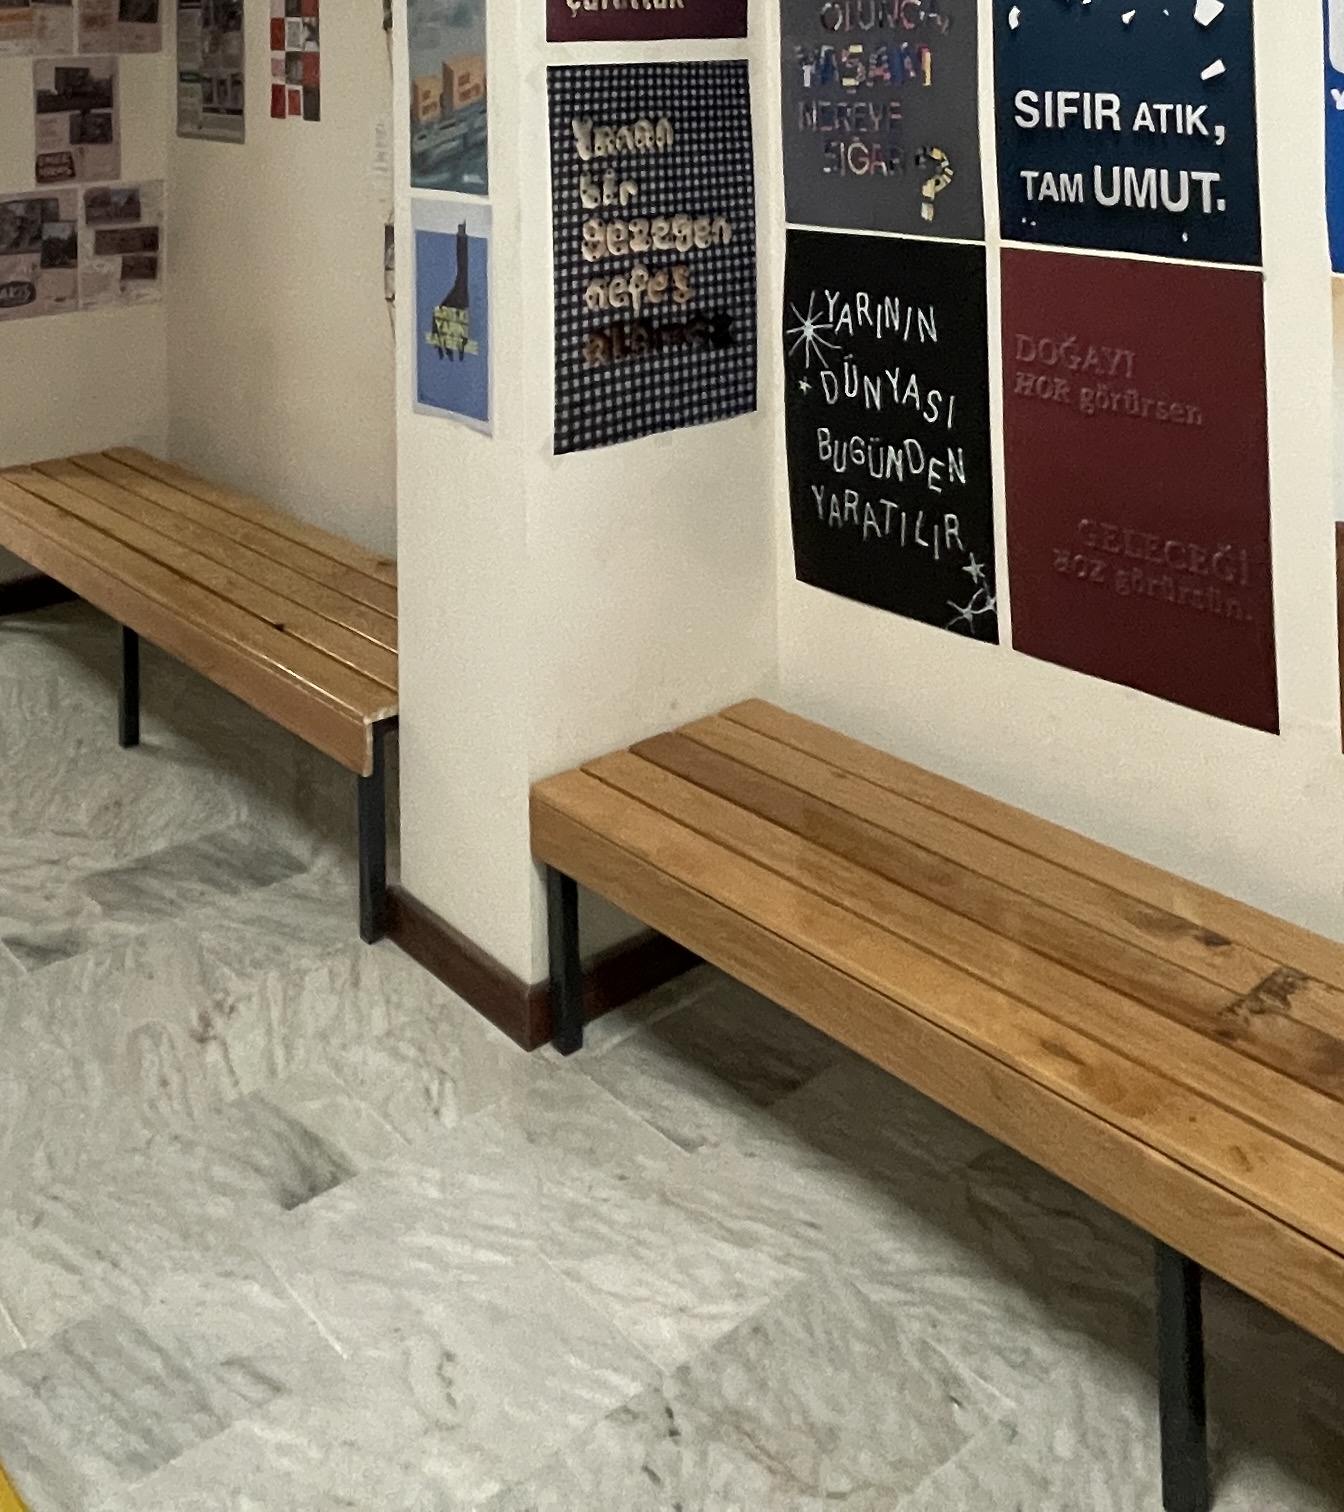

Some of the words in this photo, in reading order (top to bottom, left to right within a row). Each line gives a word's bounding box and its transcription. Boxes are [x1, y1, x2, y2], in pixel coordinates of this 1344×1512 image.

[1014, 89, 1121, 131] SIFIR
[1133, 103, 1226, 145] ATIK,
[580, 169, 638, 209] bir
[1020, 170, 1084, 203] TAM
[1093, 165, 1227, 214] UMUT.
[581, 213, 732, 262] gezegen
[585, 264, 694, 316] nefes
[824, 290, 938, 343] YARININ
[1015, 333, 1135, 379] DOĞAYI
[820, 355, 956, 427] DÜNYASI
[1014, 371, 1071, 404] HOR
[1079, 382, 1203, 426] görürsen
[818, 427, 966, 493] BUGÜNDEN
[812, 486, 964, 560] YARATILIR
